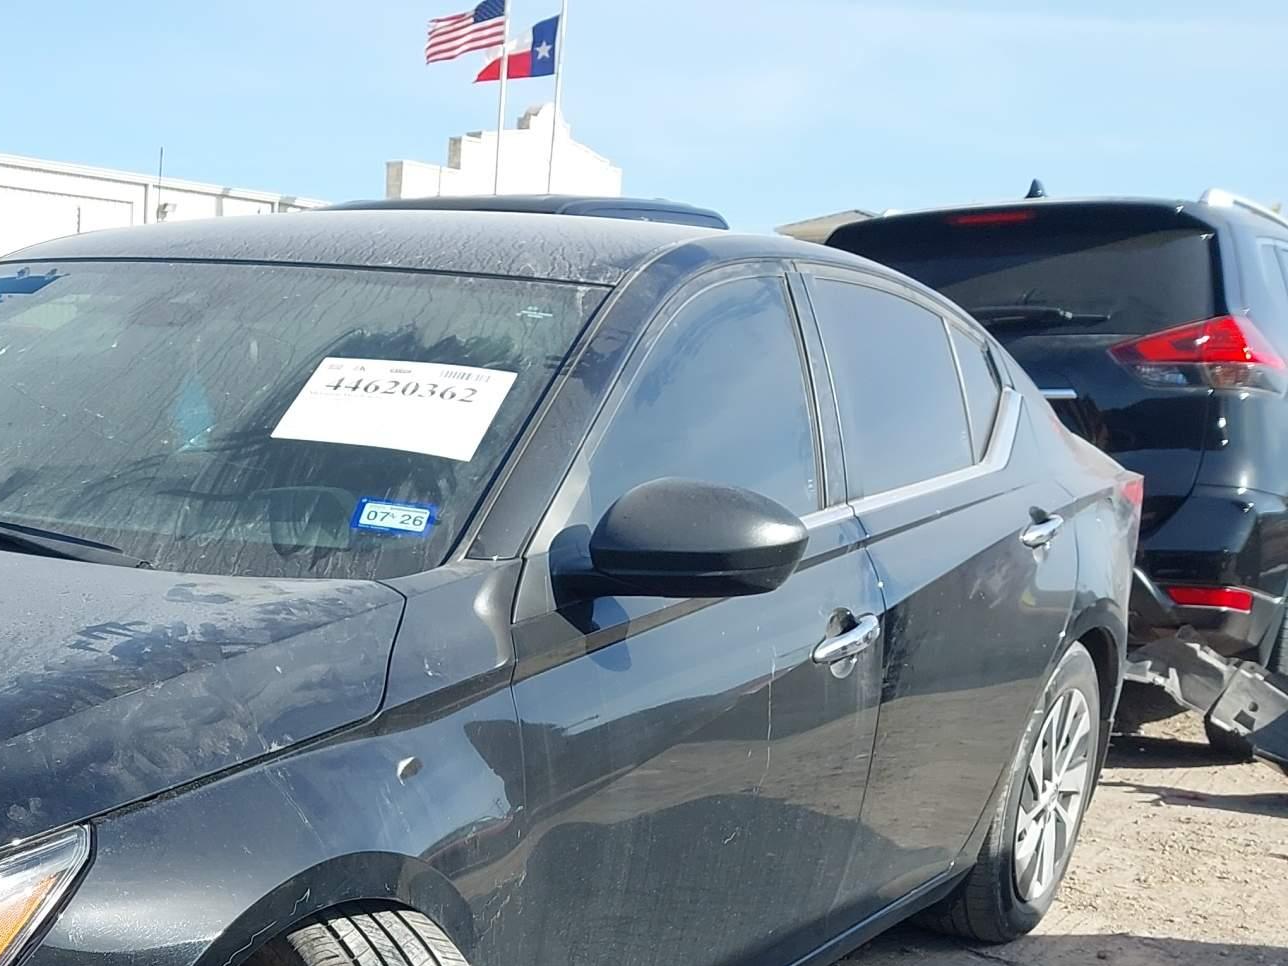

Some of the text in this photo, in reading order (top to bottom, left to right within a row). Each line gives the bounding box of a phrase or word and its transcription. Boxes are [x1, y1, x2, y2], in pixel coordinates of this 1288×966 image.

[325, 377, 478, 403] 44620362
[366, 510, 390, 522] 07
[399, 514, 425, 527] 26
